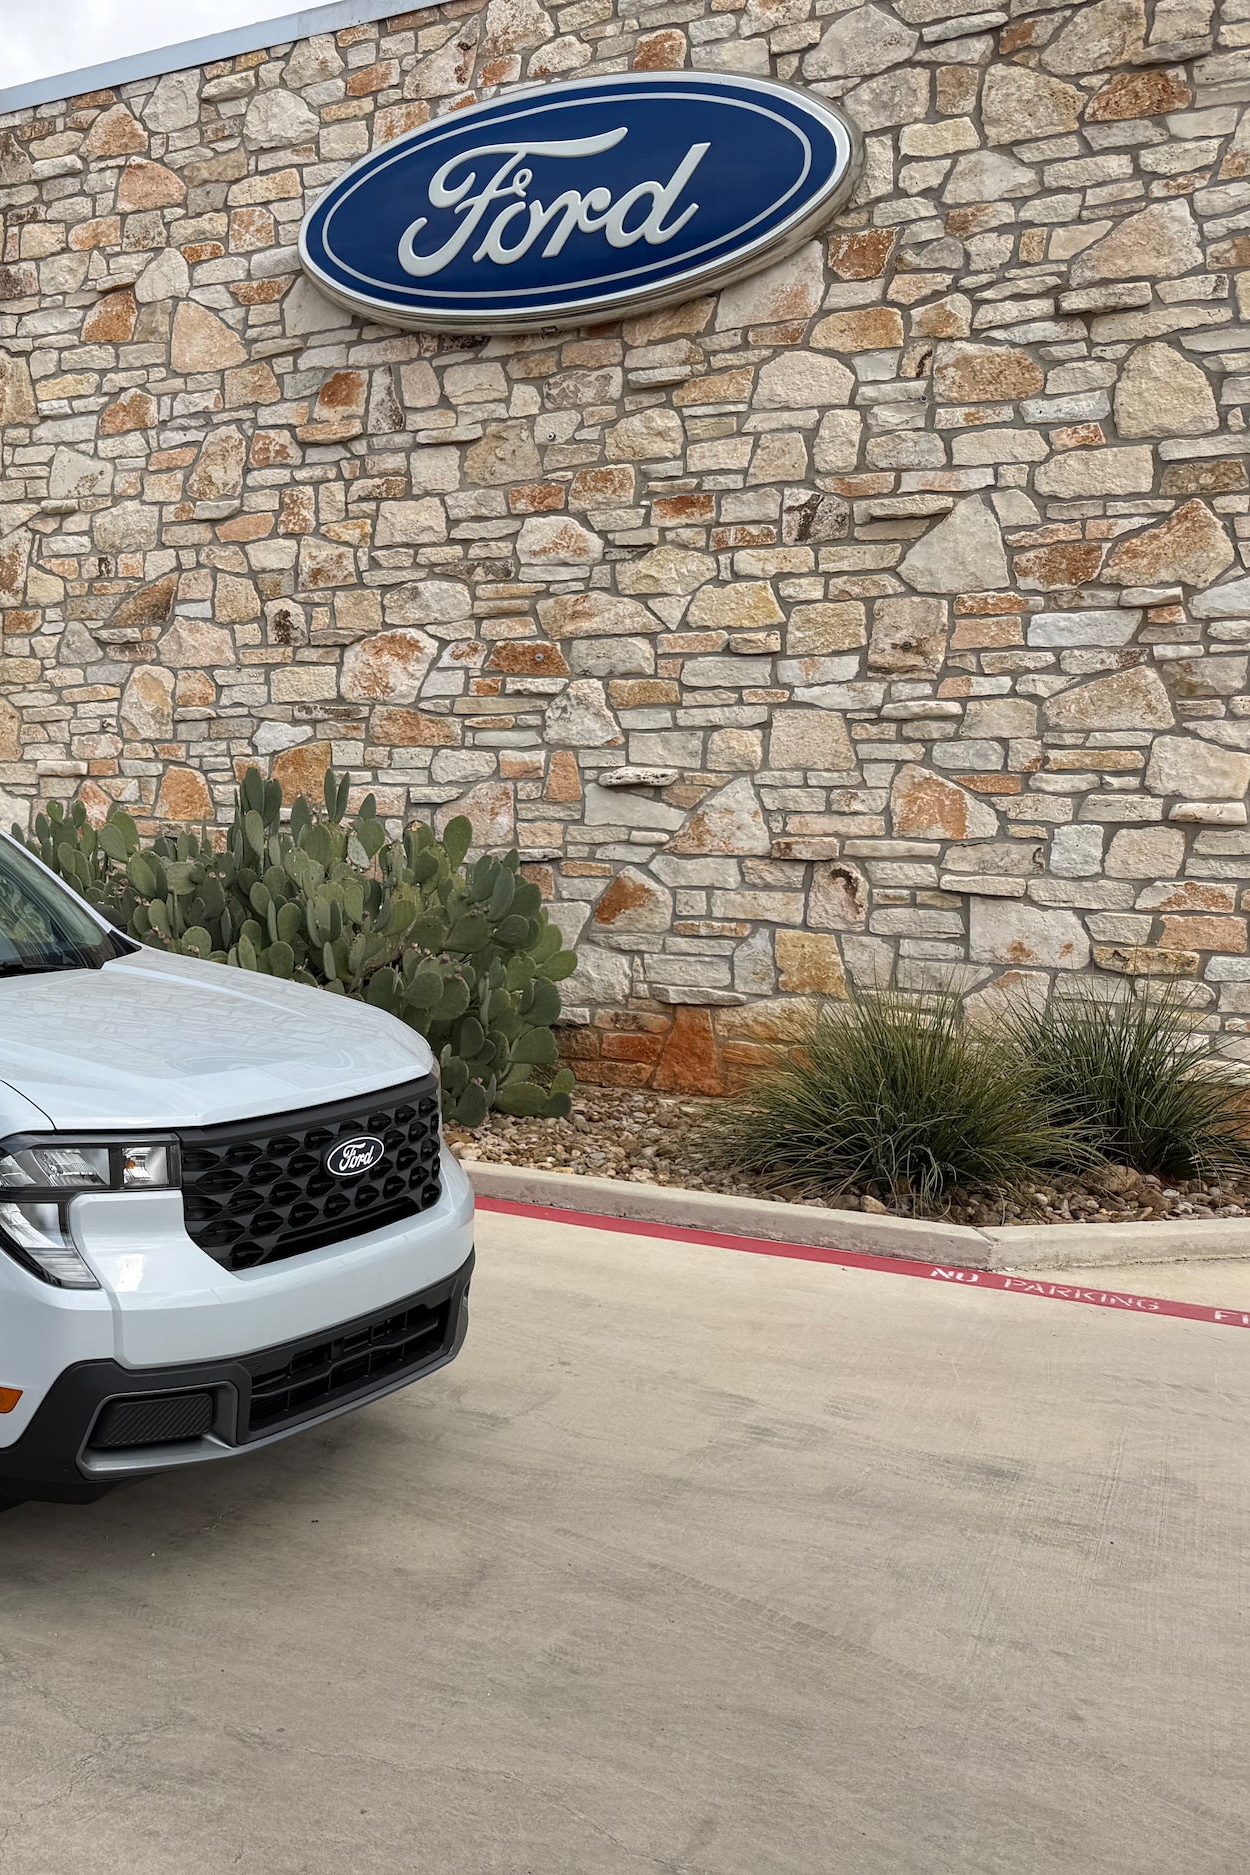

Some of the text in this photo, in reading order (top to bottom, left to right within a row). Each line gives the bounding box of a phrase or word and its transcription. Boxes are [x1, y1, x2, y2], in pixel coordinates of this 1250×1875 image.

[398, 126, 710, 277] Ford
[338, 1142, 375, 1171] Ford
[930, 1267, 979, 1282] NO
[1004, 1278, 1159, 1311] PARKING
